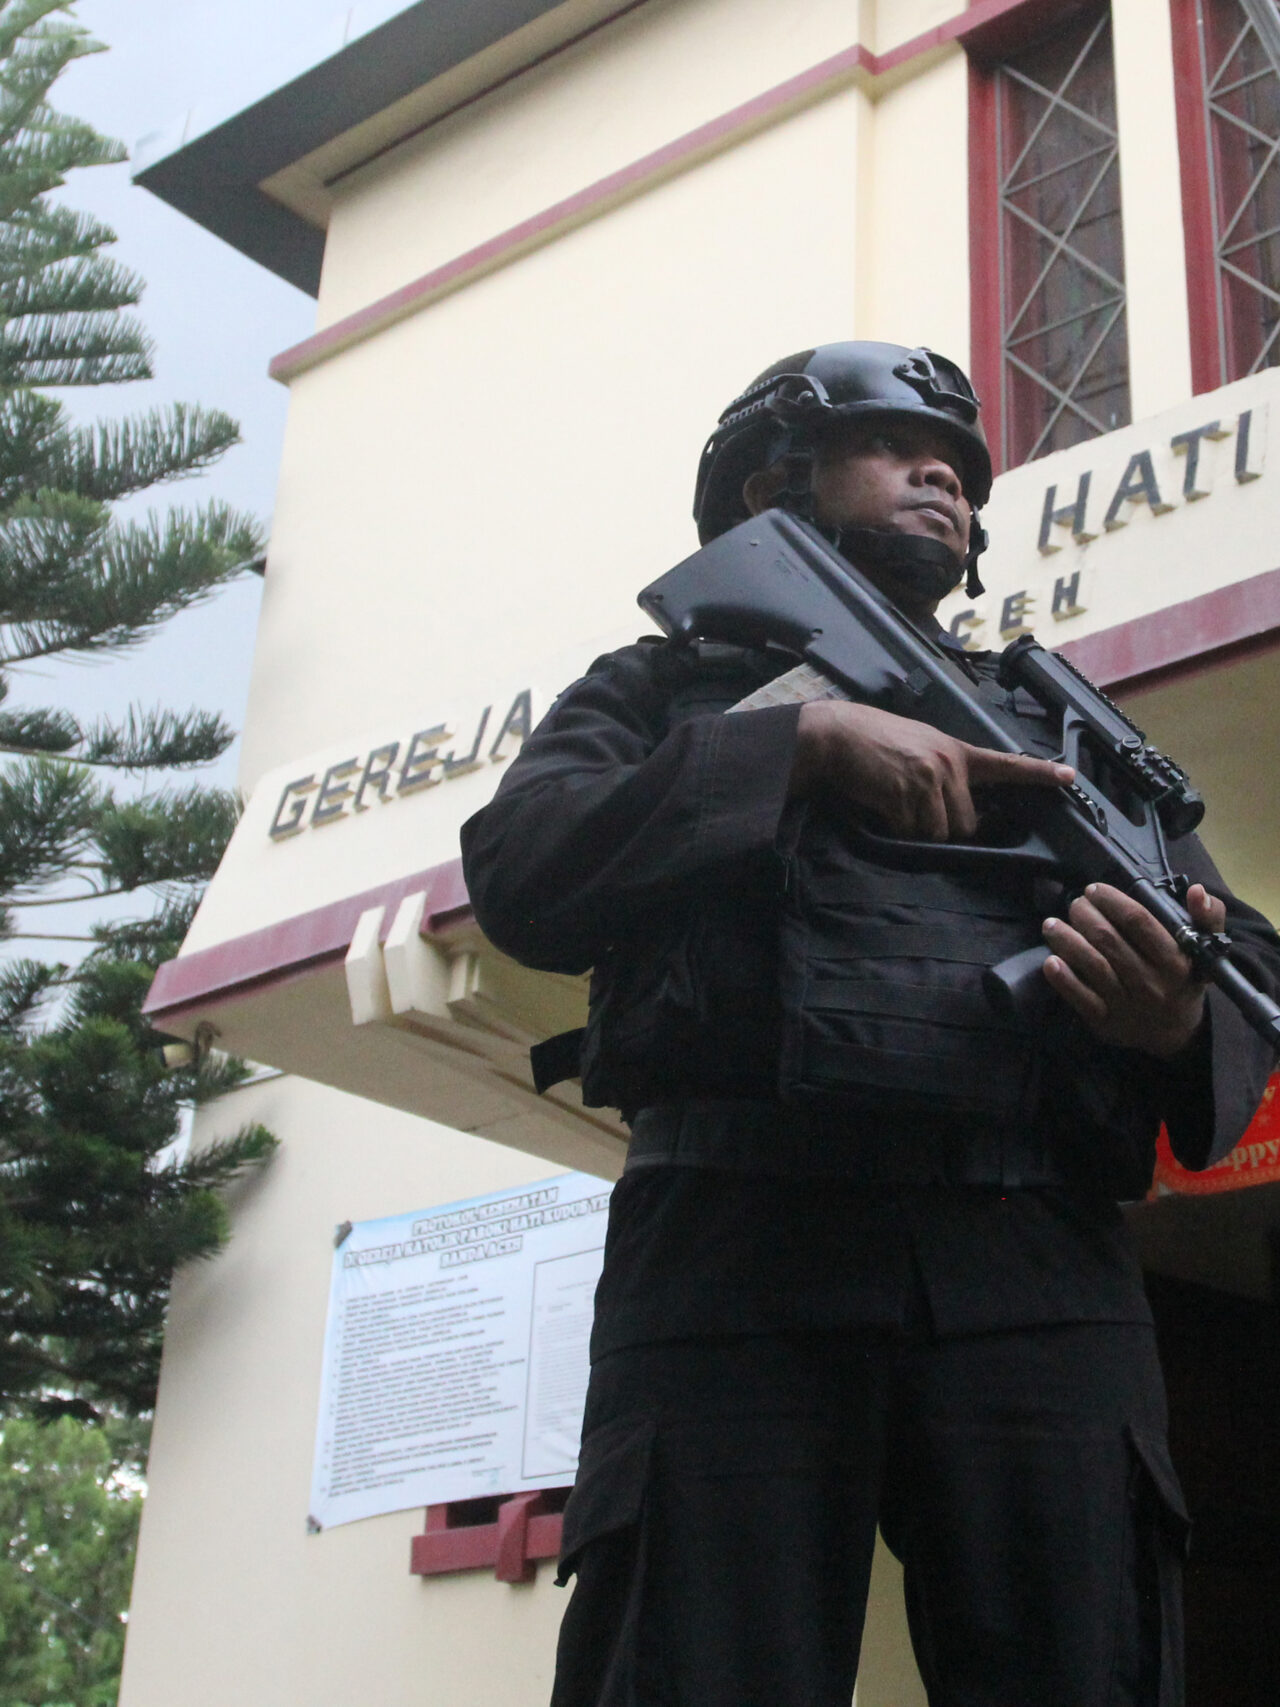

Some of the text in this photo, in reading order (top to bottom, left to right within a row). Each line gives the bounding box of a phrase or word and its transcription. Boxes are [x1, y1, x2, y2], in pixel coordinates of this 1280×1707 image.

[269, 688, 531, 840] GEREJA
[1037, 408, 1260, 553] HATI
[948, 570, 1084, 648] CEH
